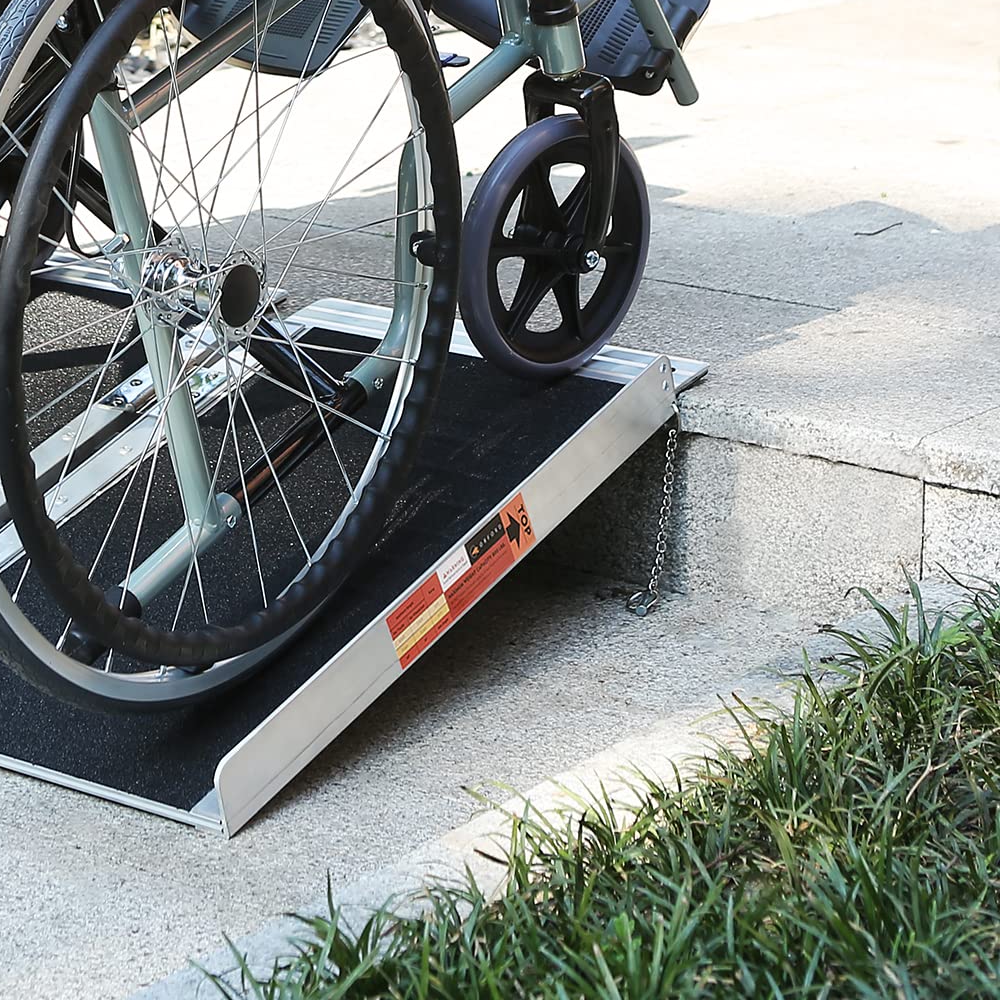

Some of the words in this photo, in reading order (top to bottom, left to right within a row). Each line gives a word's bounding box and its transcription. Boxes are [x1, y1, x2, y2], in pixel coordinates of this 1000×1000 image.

[518, 504, 532, 535] TOP
[446, 557, 465, 576] WARNING
[463, 569, 477, 584] WEIGHT
[476, 554, 492, 573] CAPACITY
